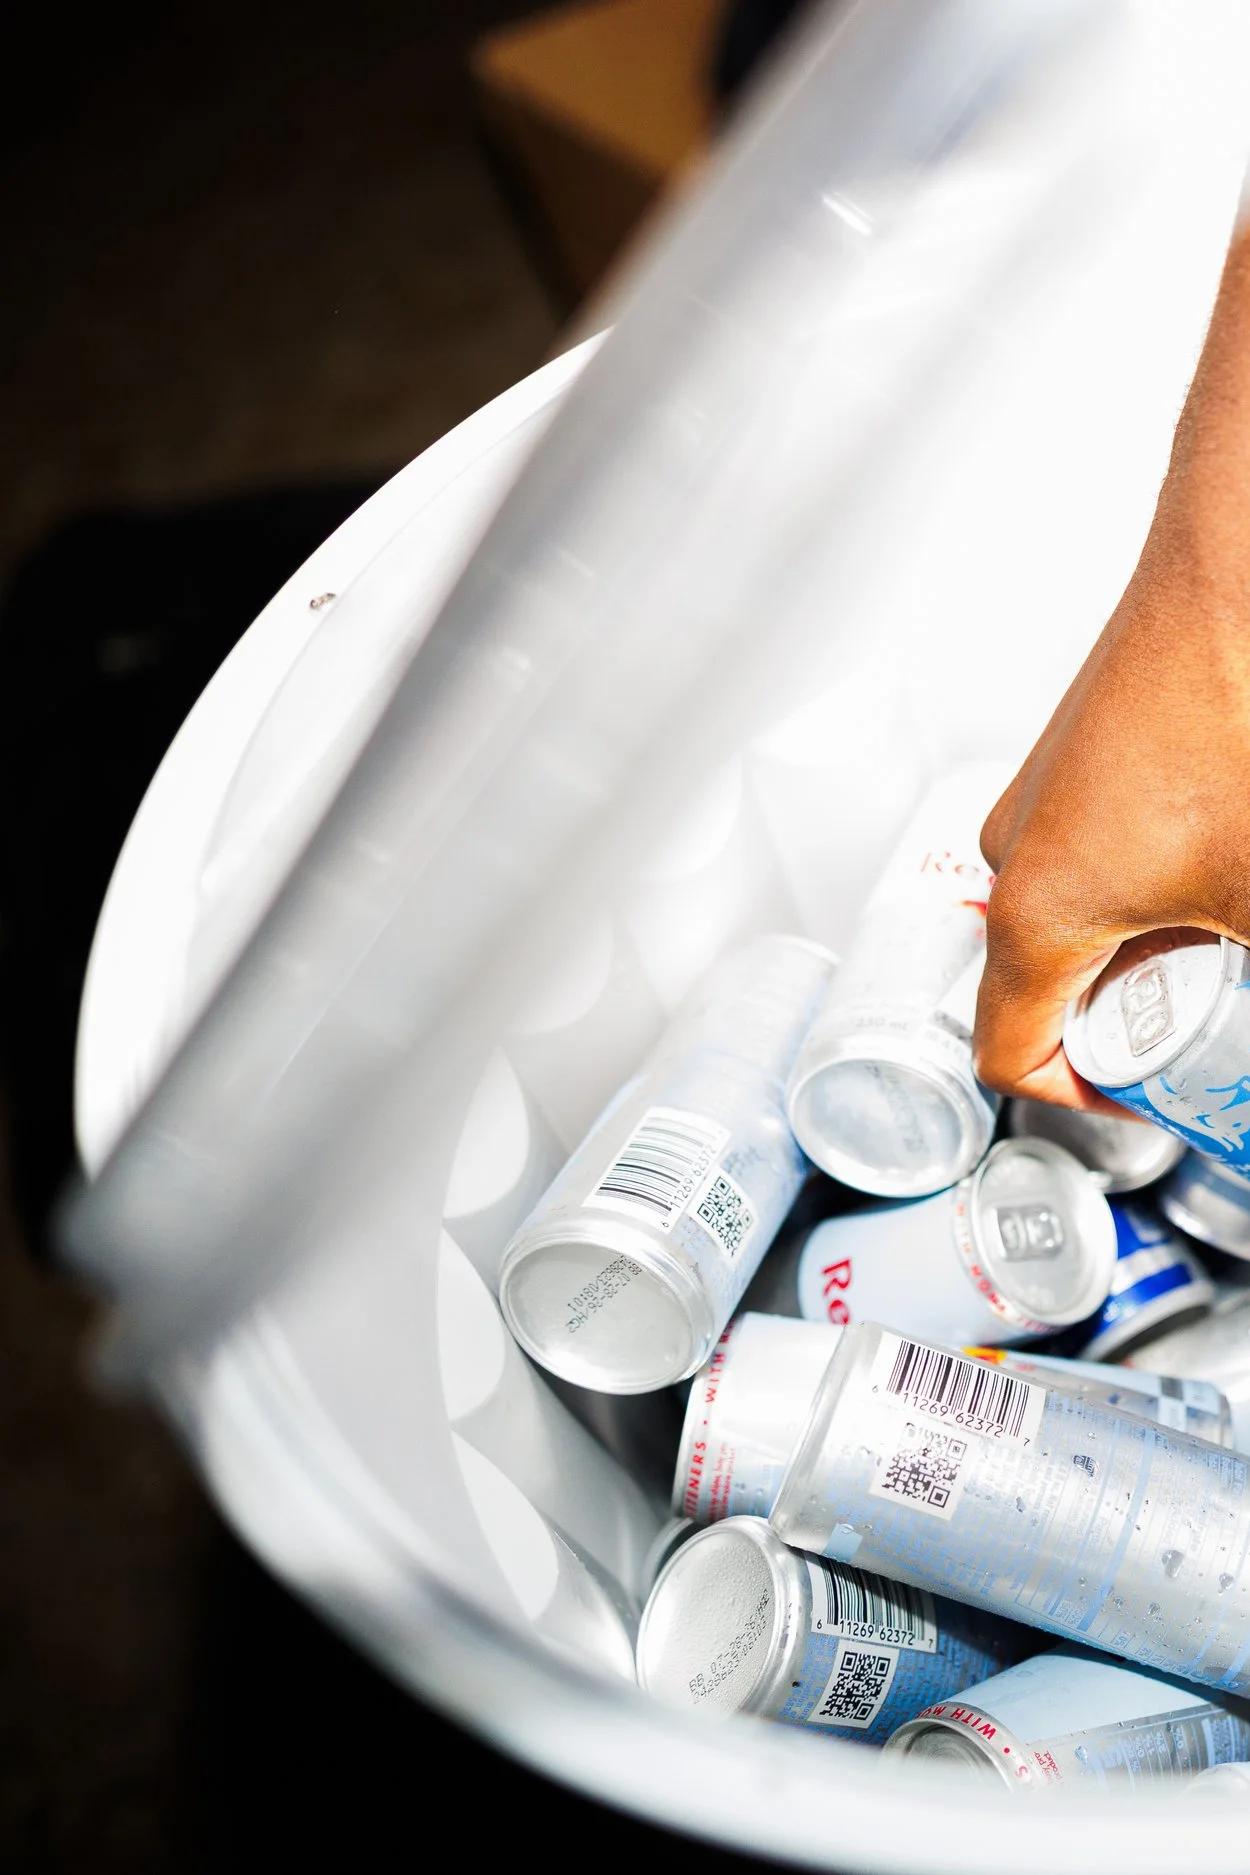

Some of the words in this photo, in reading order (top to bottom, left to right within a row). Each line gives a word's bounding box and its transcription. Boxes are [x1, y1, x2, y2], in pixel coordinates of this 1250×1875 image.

[919, 850, 990, 886] Re
[667, 1176, 696, 1210] 11269
[690, 1143, 718, 1178] 62372
[821, 1257, 851, 1325] Re
[704, 1352, 724, 1403] WITH
[871, 1383, 880, 1394] 6
[901, 1391, 949, 1418] 11269
[954, 1411, 1004, 1438] 62372
[1022, 1437, 1030, 1447] 7
[816, 1619, 823, 1629] 6
[838, 1619, 874, 1638] 11269
[879, 1628, 914, 1645] 62372
[927, 1638, 933, 1648] 7
[950, 1708, 996, 1740] WITH
